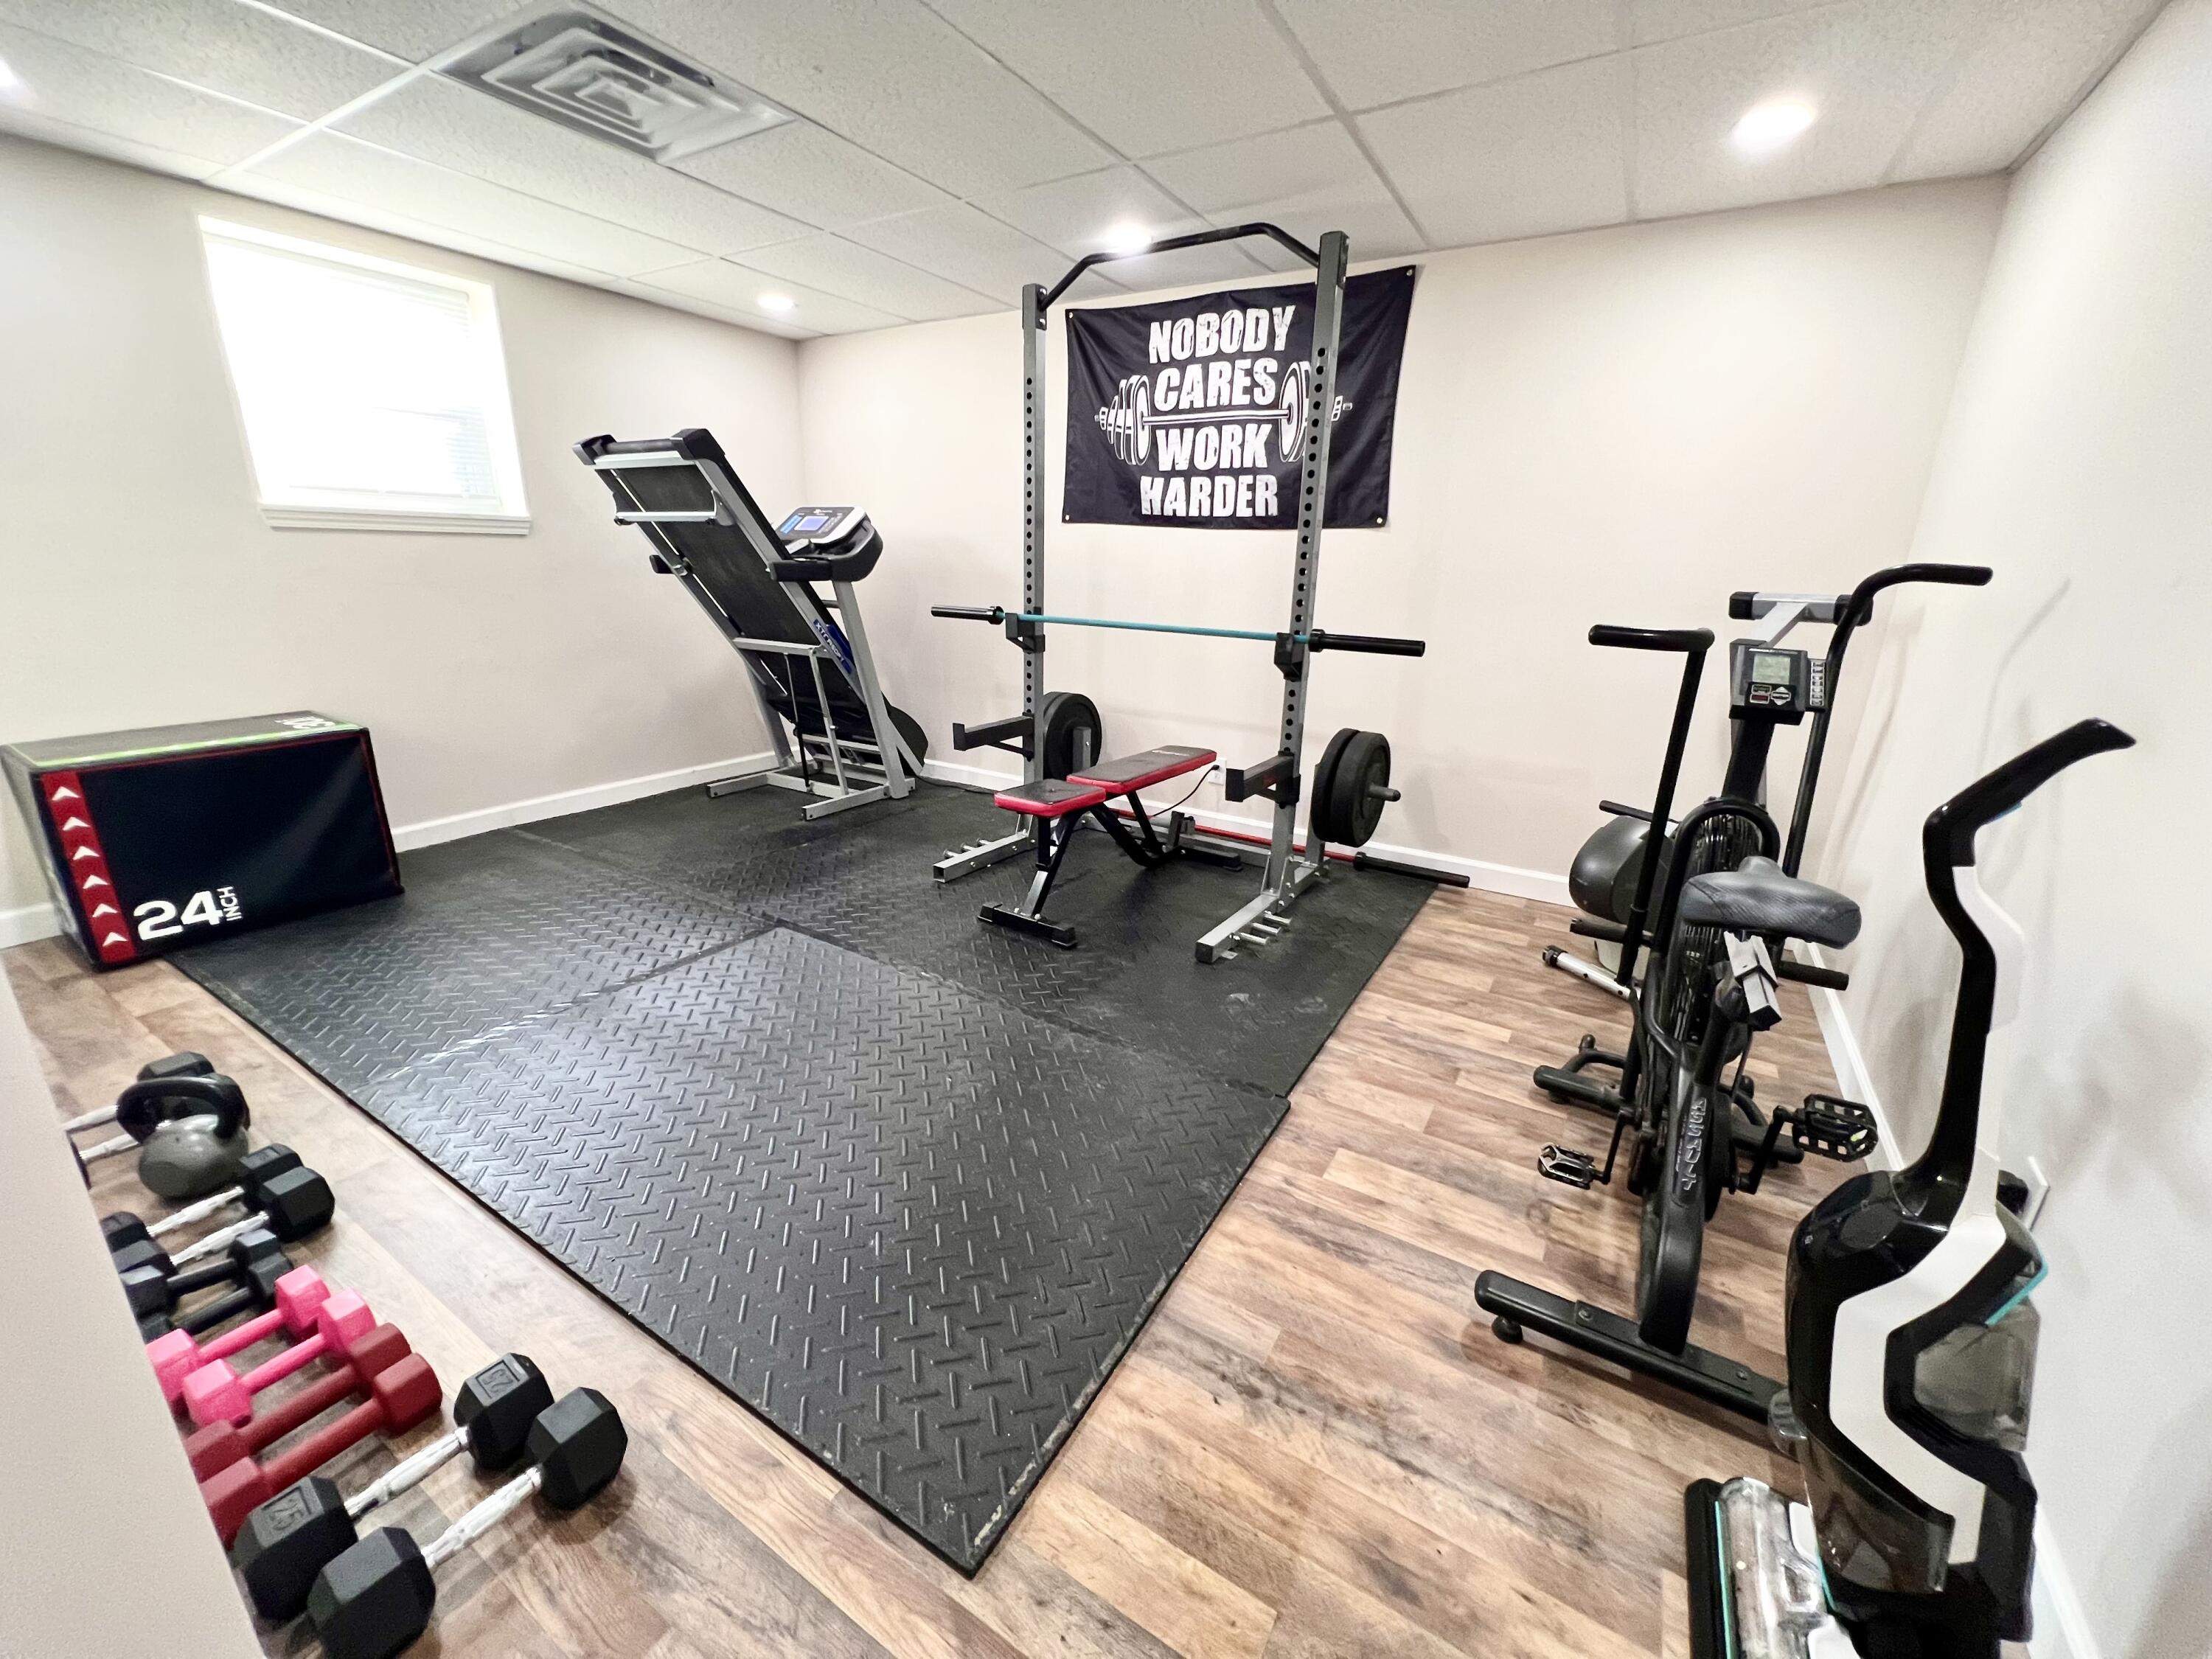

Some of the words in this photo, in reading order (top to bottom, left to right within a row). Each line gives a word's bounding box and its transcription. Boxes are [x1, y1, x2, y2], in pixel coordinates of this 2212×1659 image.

[1148, 305, 1296, 364] NOBODY
[1154, 357, 1279, 411] CARES
[1155, 423, 1273, 471] WORK
[1140, 474, 1278, 517] HARDER
[133, 891, 223, 941] 24
[217, 886, 243, 921] INCH
[482, 1368, 514, 1394] 25
